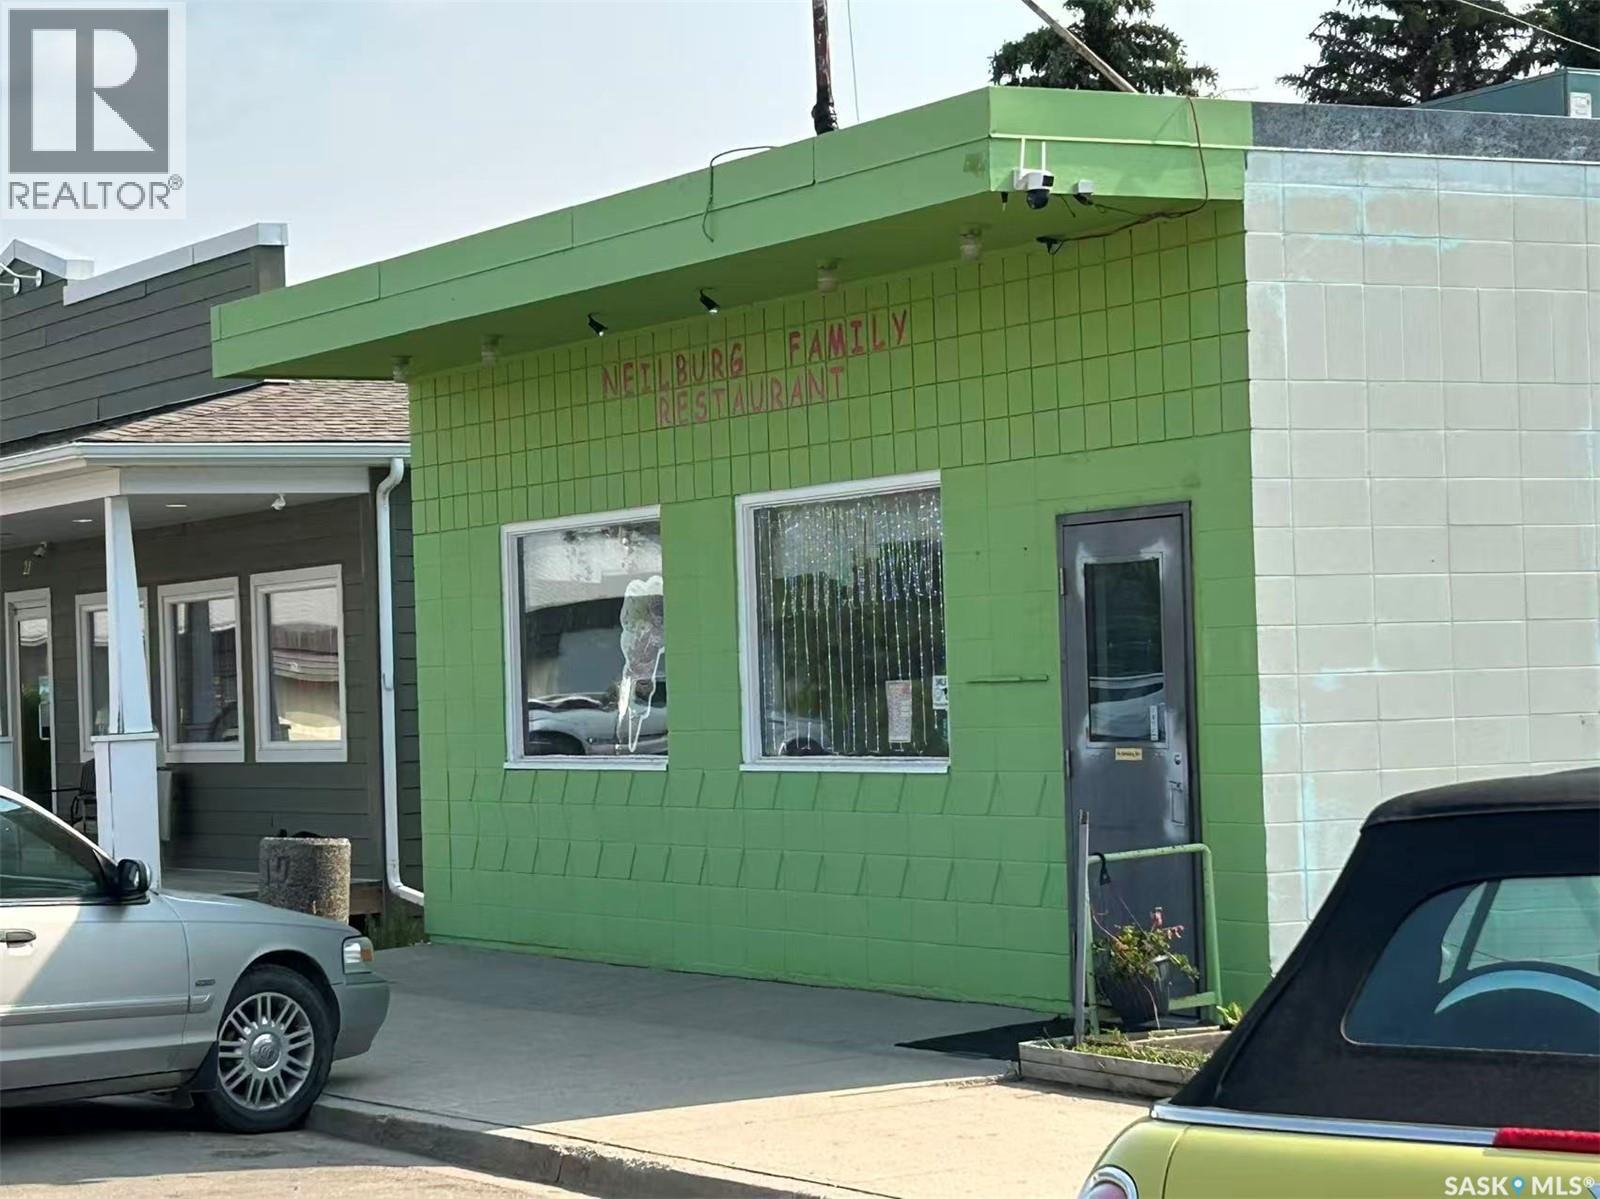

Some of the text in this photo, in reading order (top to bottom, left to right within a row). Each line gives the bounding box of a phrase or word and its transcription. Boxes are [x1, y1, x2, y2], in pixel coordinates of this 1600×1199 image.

[602, 309, 907, 398] NEILBURG FAMILY
[658, 366, 844, 427] RESTAURANT
